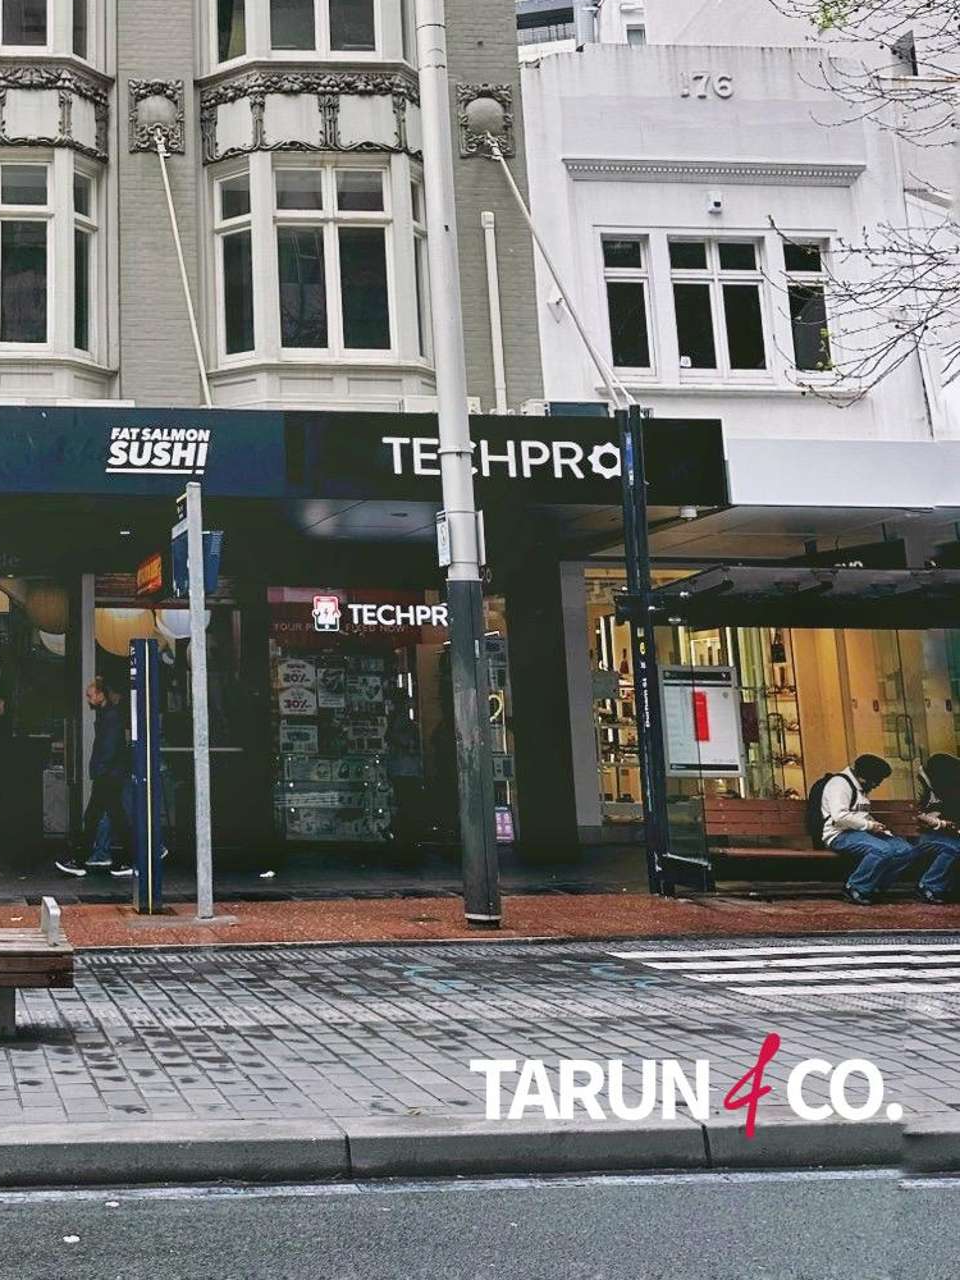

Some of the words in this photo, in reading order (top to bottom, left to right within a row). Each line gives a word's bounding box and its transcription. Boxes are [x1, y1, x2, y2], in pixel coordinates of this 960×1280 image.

[111, 427, 140, 440] FAT
[141, 428, 210, 441] SALMON
[382, 437, 621, 479] TEHPRO
[348, 603, 448, 627] TECHPR
